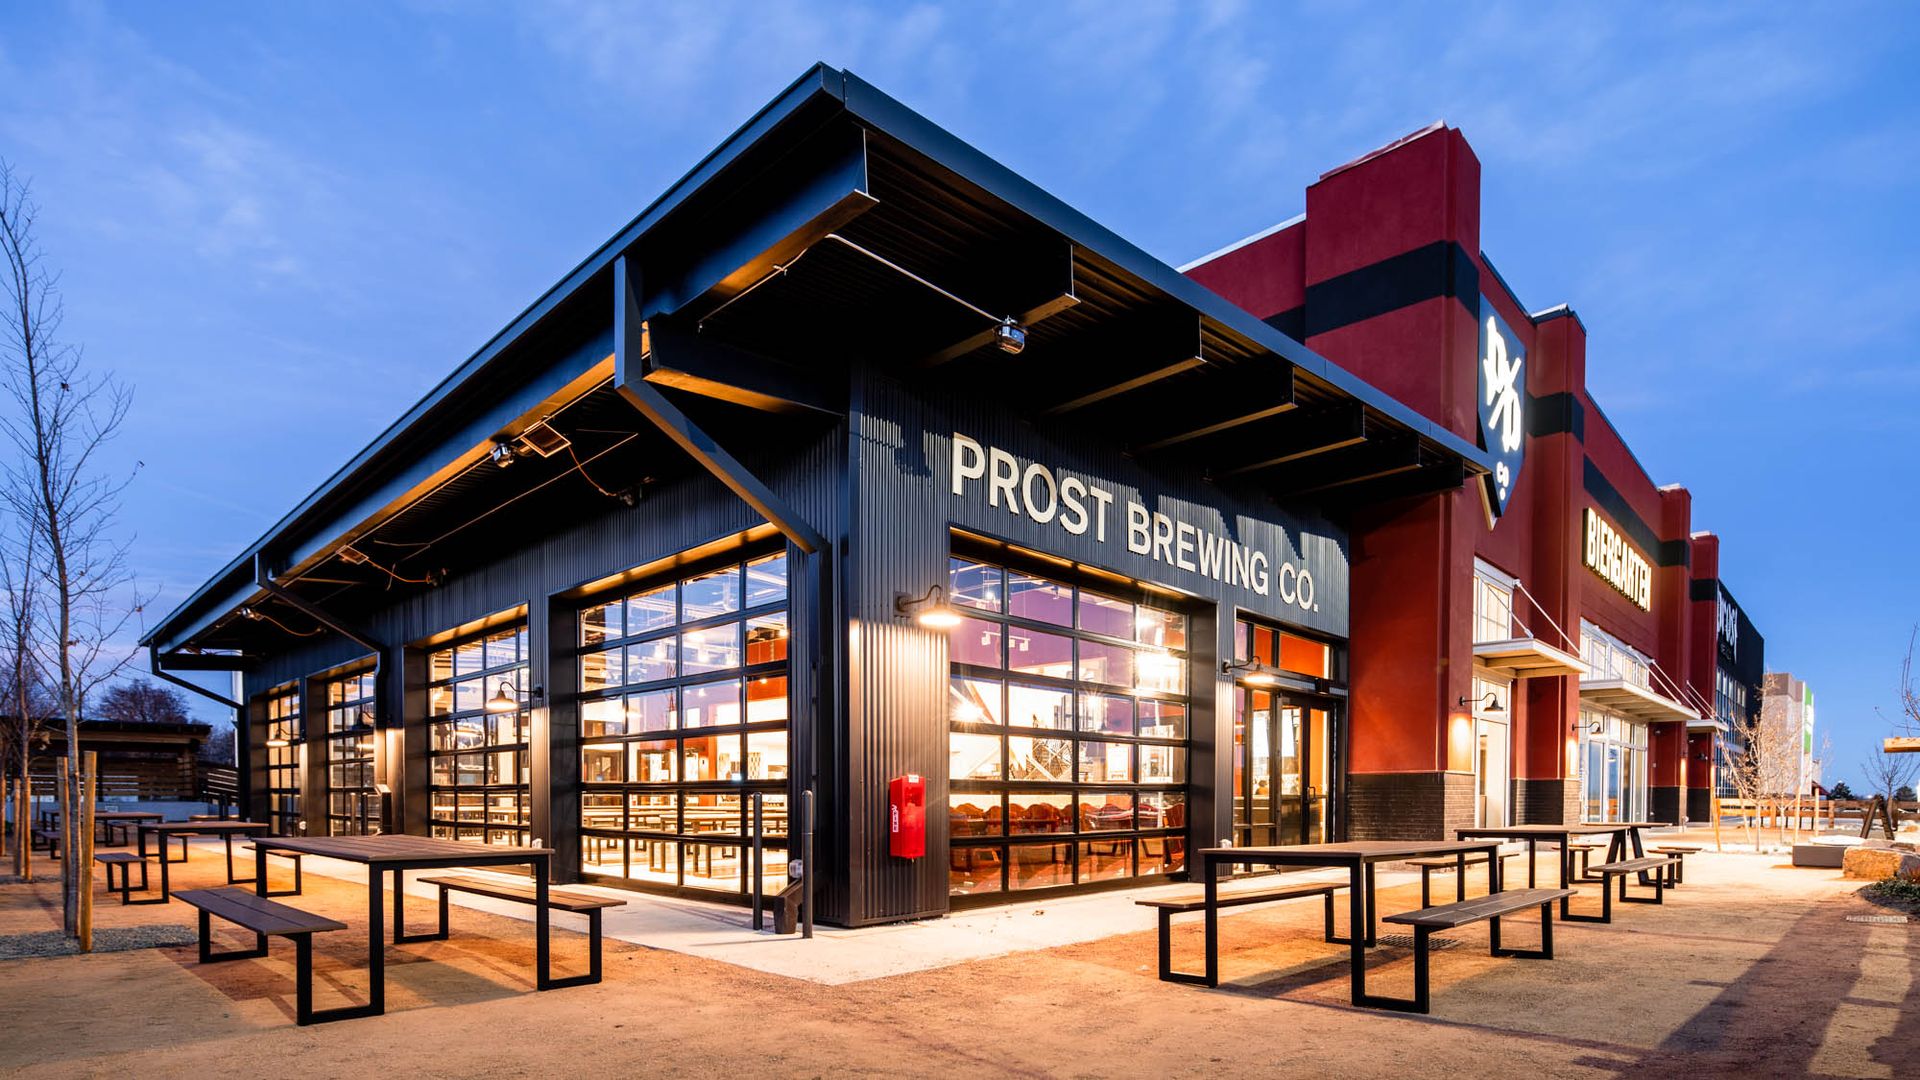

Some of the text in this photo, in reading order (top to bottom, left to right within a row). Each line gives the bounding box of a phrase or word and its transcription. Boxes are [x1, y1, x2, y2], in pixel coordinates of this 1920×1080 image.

[952, 431, 1319, 613] PROST BREWING CO.
[1586, 507, 1652, 612] BIERGARTEN
